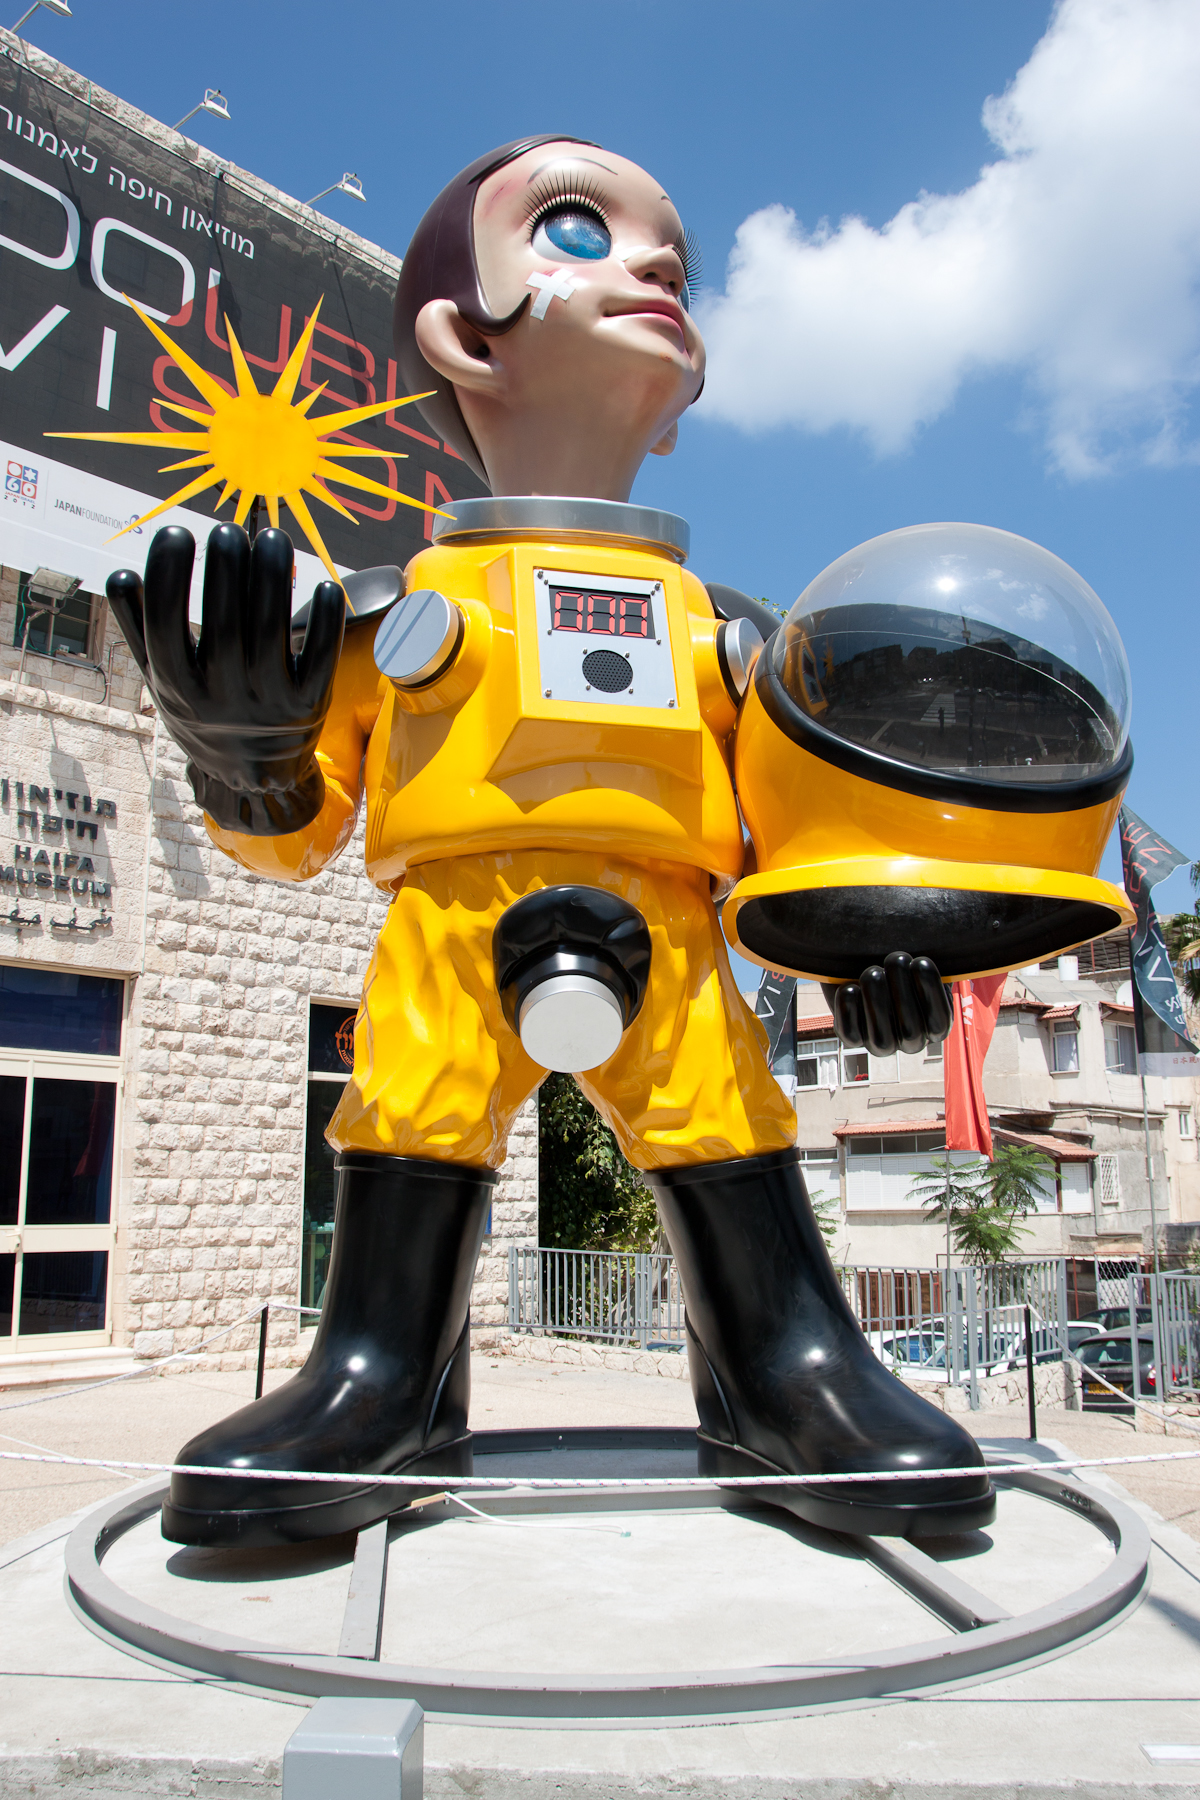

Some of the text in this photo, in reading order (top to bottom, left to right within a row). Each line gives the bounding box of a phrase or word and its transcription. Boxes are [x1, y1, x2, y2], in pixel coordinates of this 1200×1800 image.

[108, 166, 173, 216] חיפה
[182, 205, 255, 260] מוזיאון
[1, 778, 117, 819] מוזיאון
[17, 809, 99, 840] חיפה
[15, 844, 95, 873] HAIFA
[0, 864, 112, 898] MUSEUM
